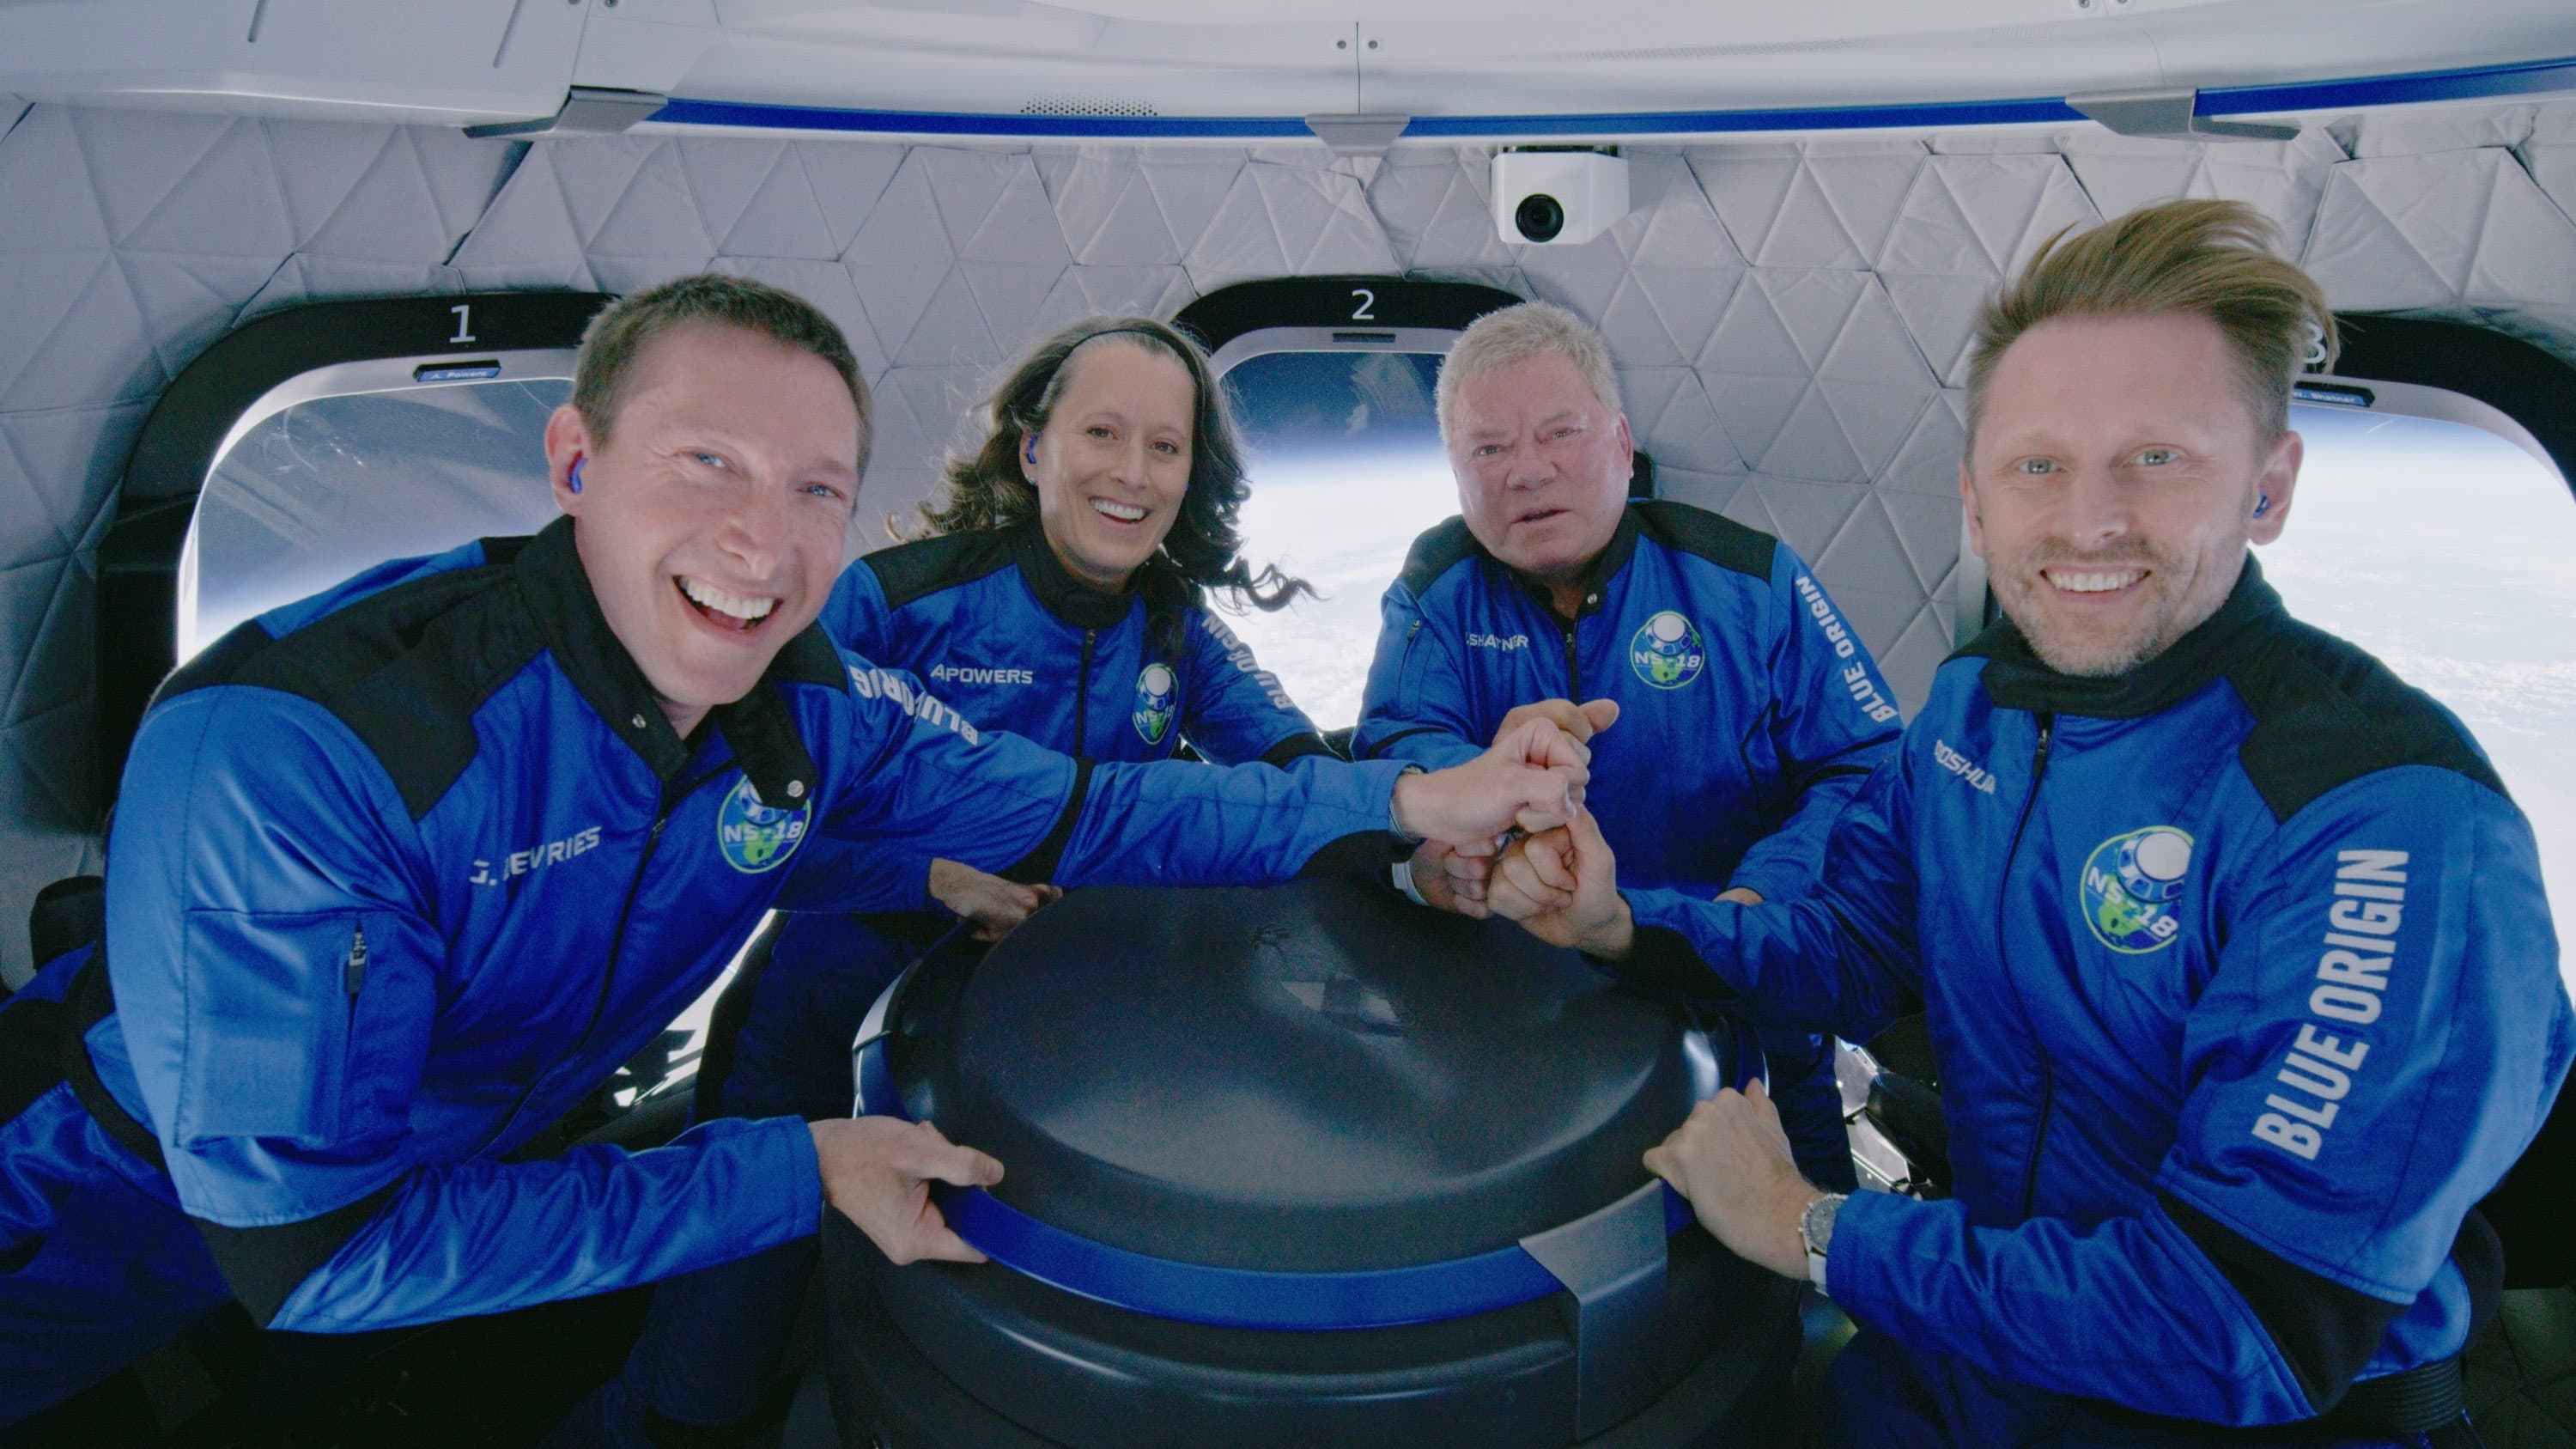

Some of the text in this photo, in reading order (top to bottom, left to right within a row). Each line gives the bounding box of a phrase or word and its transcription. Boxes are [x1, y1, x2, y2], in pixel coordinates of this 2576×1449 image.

[449, 304, 477, 344] 1
[1352, 288, 1375, 320] 2
[1634, 650, 1702, 668] NS-18
[1795, 575, 1899, 723] BLUE ORIGIN
[1253, 672, 1296, 710] BLU
[723, 820, 805, 843] NS-18
[501, 825, 602, 881] EVRIES
[2087, 866, 2179, 939] NS-18
[2251, 849, 2409, 1161] BLUE ORIGIN
